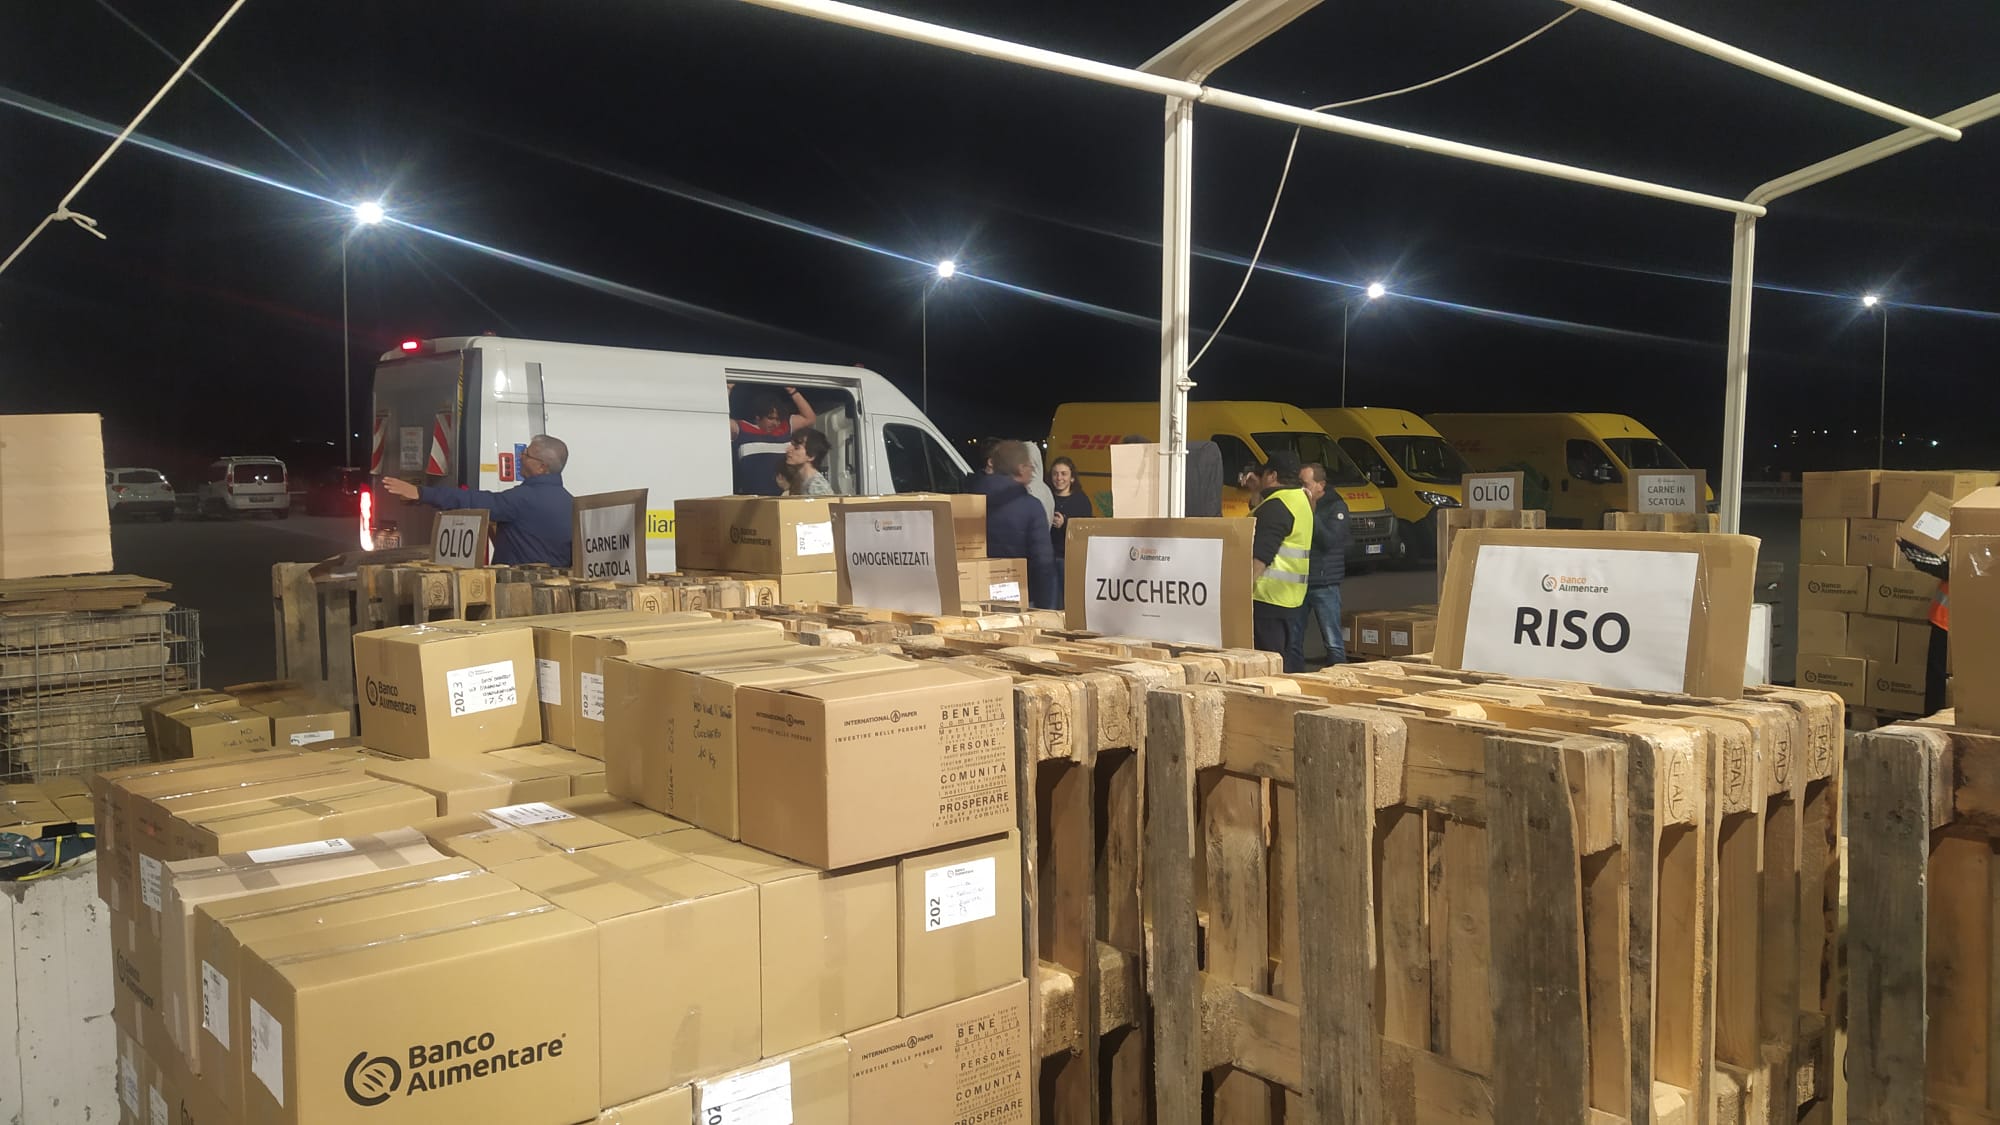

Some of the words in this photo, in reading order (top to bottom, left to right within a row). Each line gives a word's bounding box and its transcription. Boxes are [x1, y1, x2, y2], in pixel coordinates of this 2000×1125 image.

[1473, 485, 1510, 501] OLIO
[1648, 485, 1675, 494] CARNE
[1677, 485, 1686, 493] IN
[1648, 498, 1686, 506] SCATOLA
[439, 528, 474, 558] OLIO
[585, 533, 618, 553] CARNE
[619, 533, 630, 550] IN
[852, 551, 929, 566] OMOGENEIZZATI
[587, 559, 631, 579] SCATOLA
[1559, 584, 1609, 593] Alimentare
[1560, 575, 1587, 585] Banco
[1096, 578, 1208, 606] ZUCCHERO
[1513, 606, 1631, 654] RISO
[378, 681, 399, 696] Banco
[844, 715, 891, 726] INTERNATIONAL
[941, 705, 980, 721] BENE
[835, 732, 872, 743] INVESTIRE
[898, 724, 927, 734] PERSONE
[1777, 740, 1788, 772] PAL
[939, 791, 1009, 814] PROSPERARE
[930, 896, 941, 928] 202
[957, 1017, 996, 1039] BENE
[408, 1032, 496, 1069] Banco
[861, 1042, 908, 1061] INTERNATIONAL
[917, 1034, 934, 1042] PAPER
[406, 1038, 563, 1097] Alimentare
